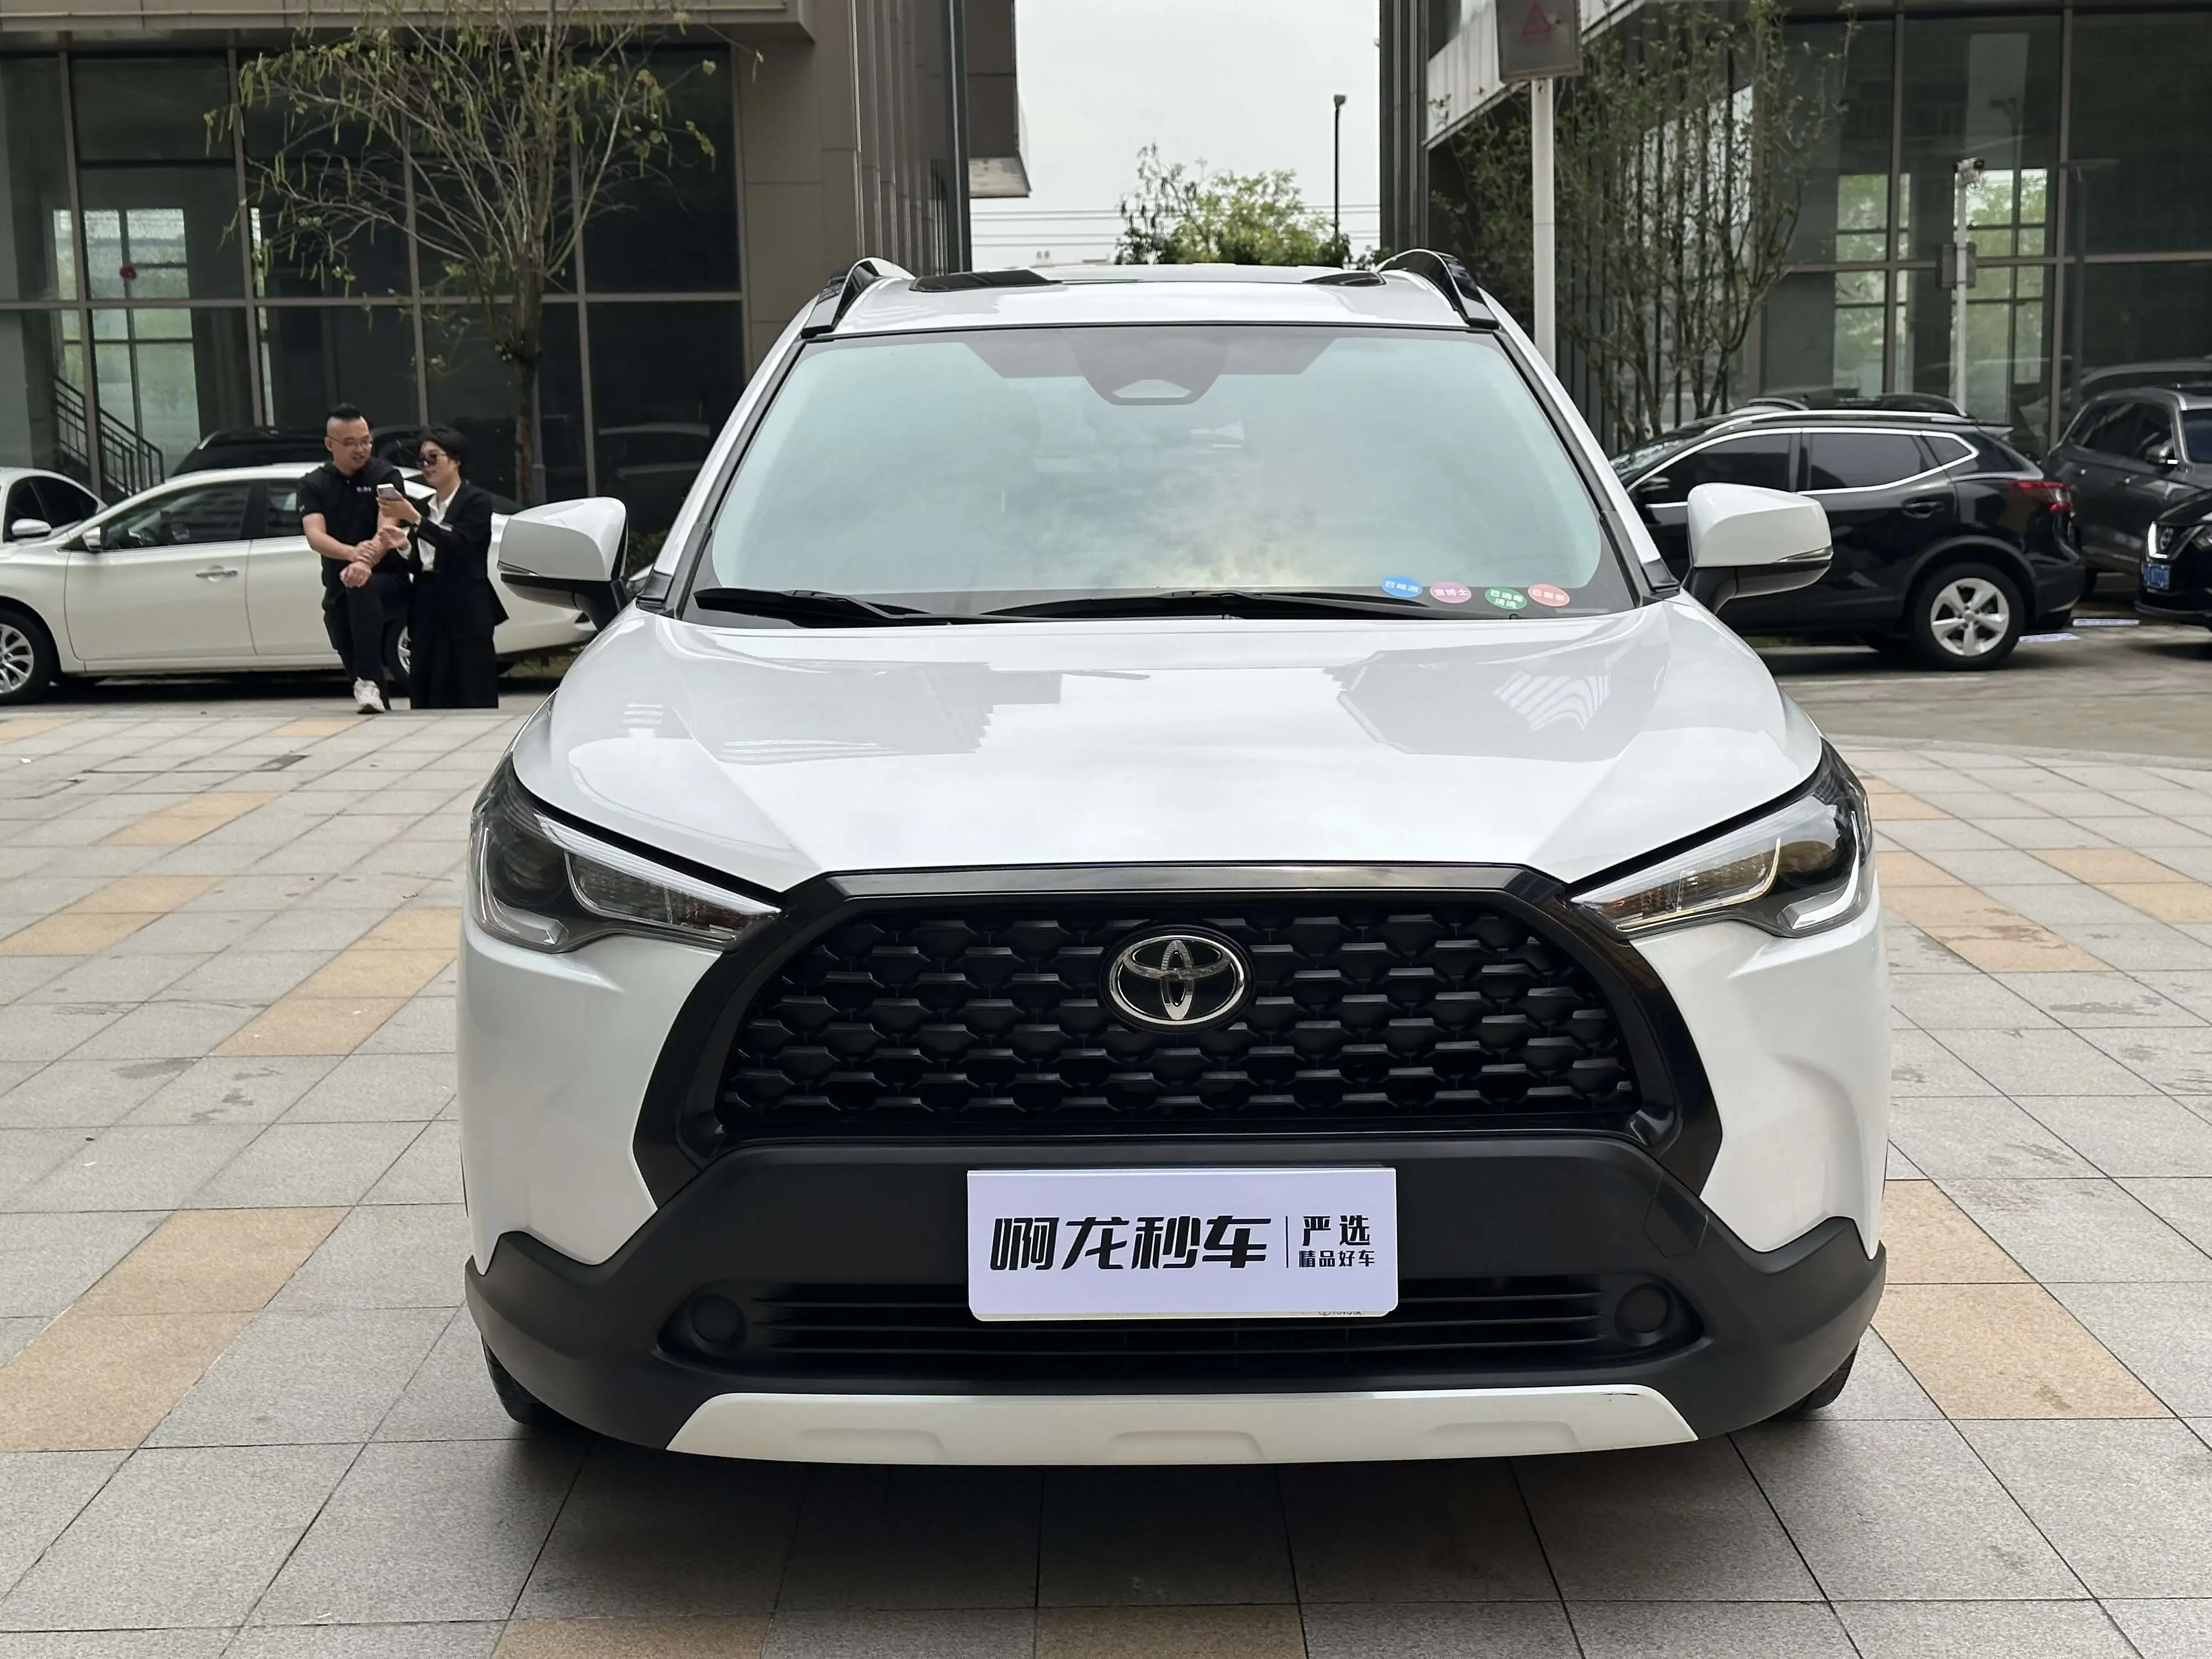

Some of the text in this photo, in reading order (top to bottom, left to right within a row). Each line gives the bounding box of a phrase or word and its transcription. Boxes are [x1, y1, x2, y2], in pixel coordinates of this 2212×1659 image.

[990, 1215, 1272, 1271] 啊龙秒车
[1302, 1215, 1371, 1247] 严选
[1298, 1250, 1375, 1268] 精品好车
